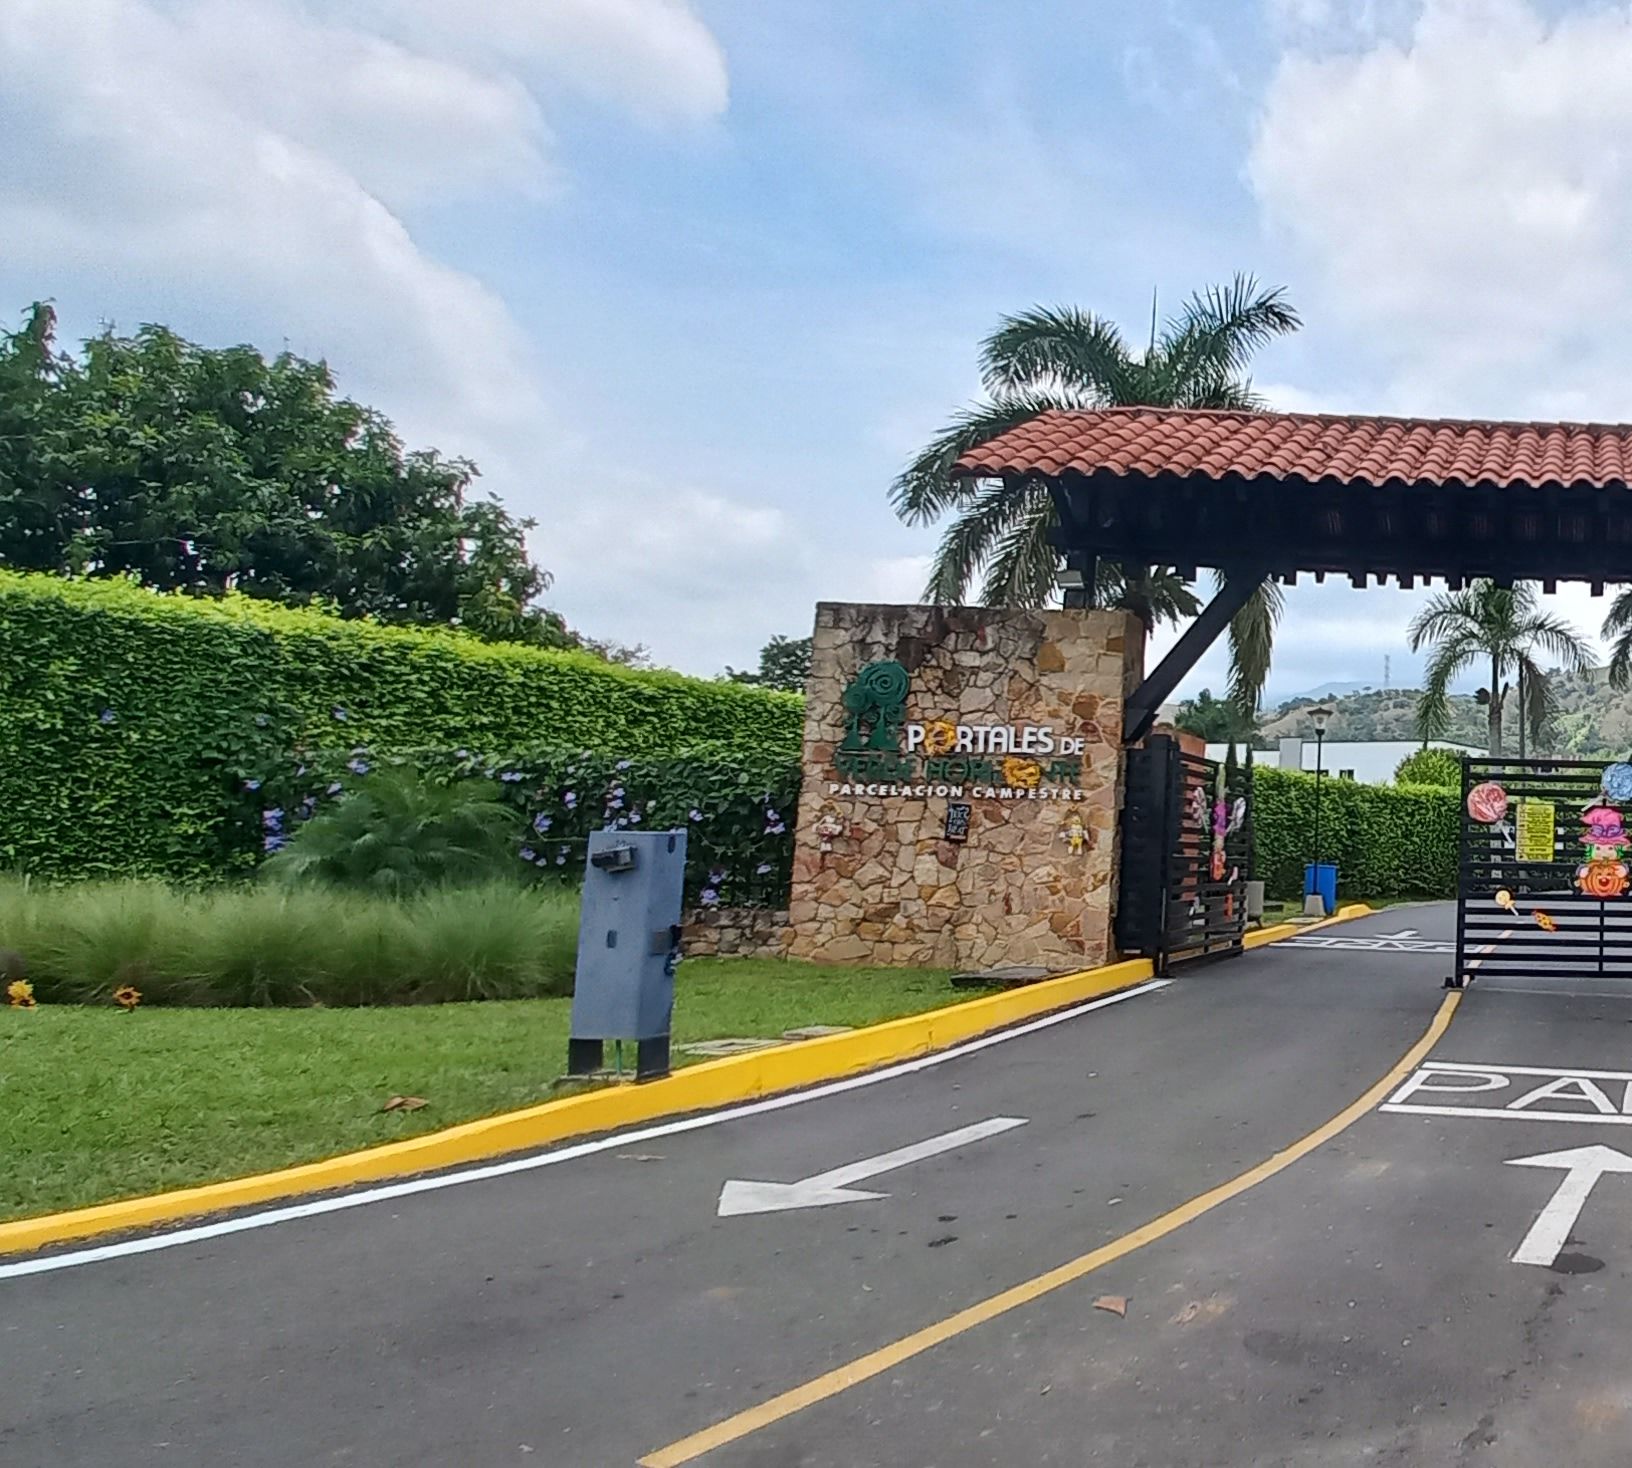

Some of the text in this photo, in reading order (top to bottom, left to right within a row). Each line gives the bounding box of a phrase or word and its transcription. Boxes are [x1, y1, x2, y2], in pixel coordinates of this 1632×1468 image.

[1060, 736, 1086, 756] DE
[828, 782, 1083, 800] PARCELACION CAMPESTRE
